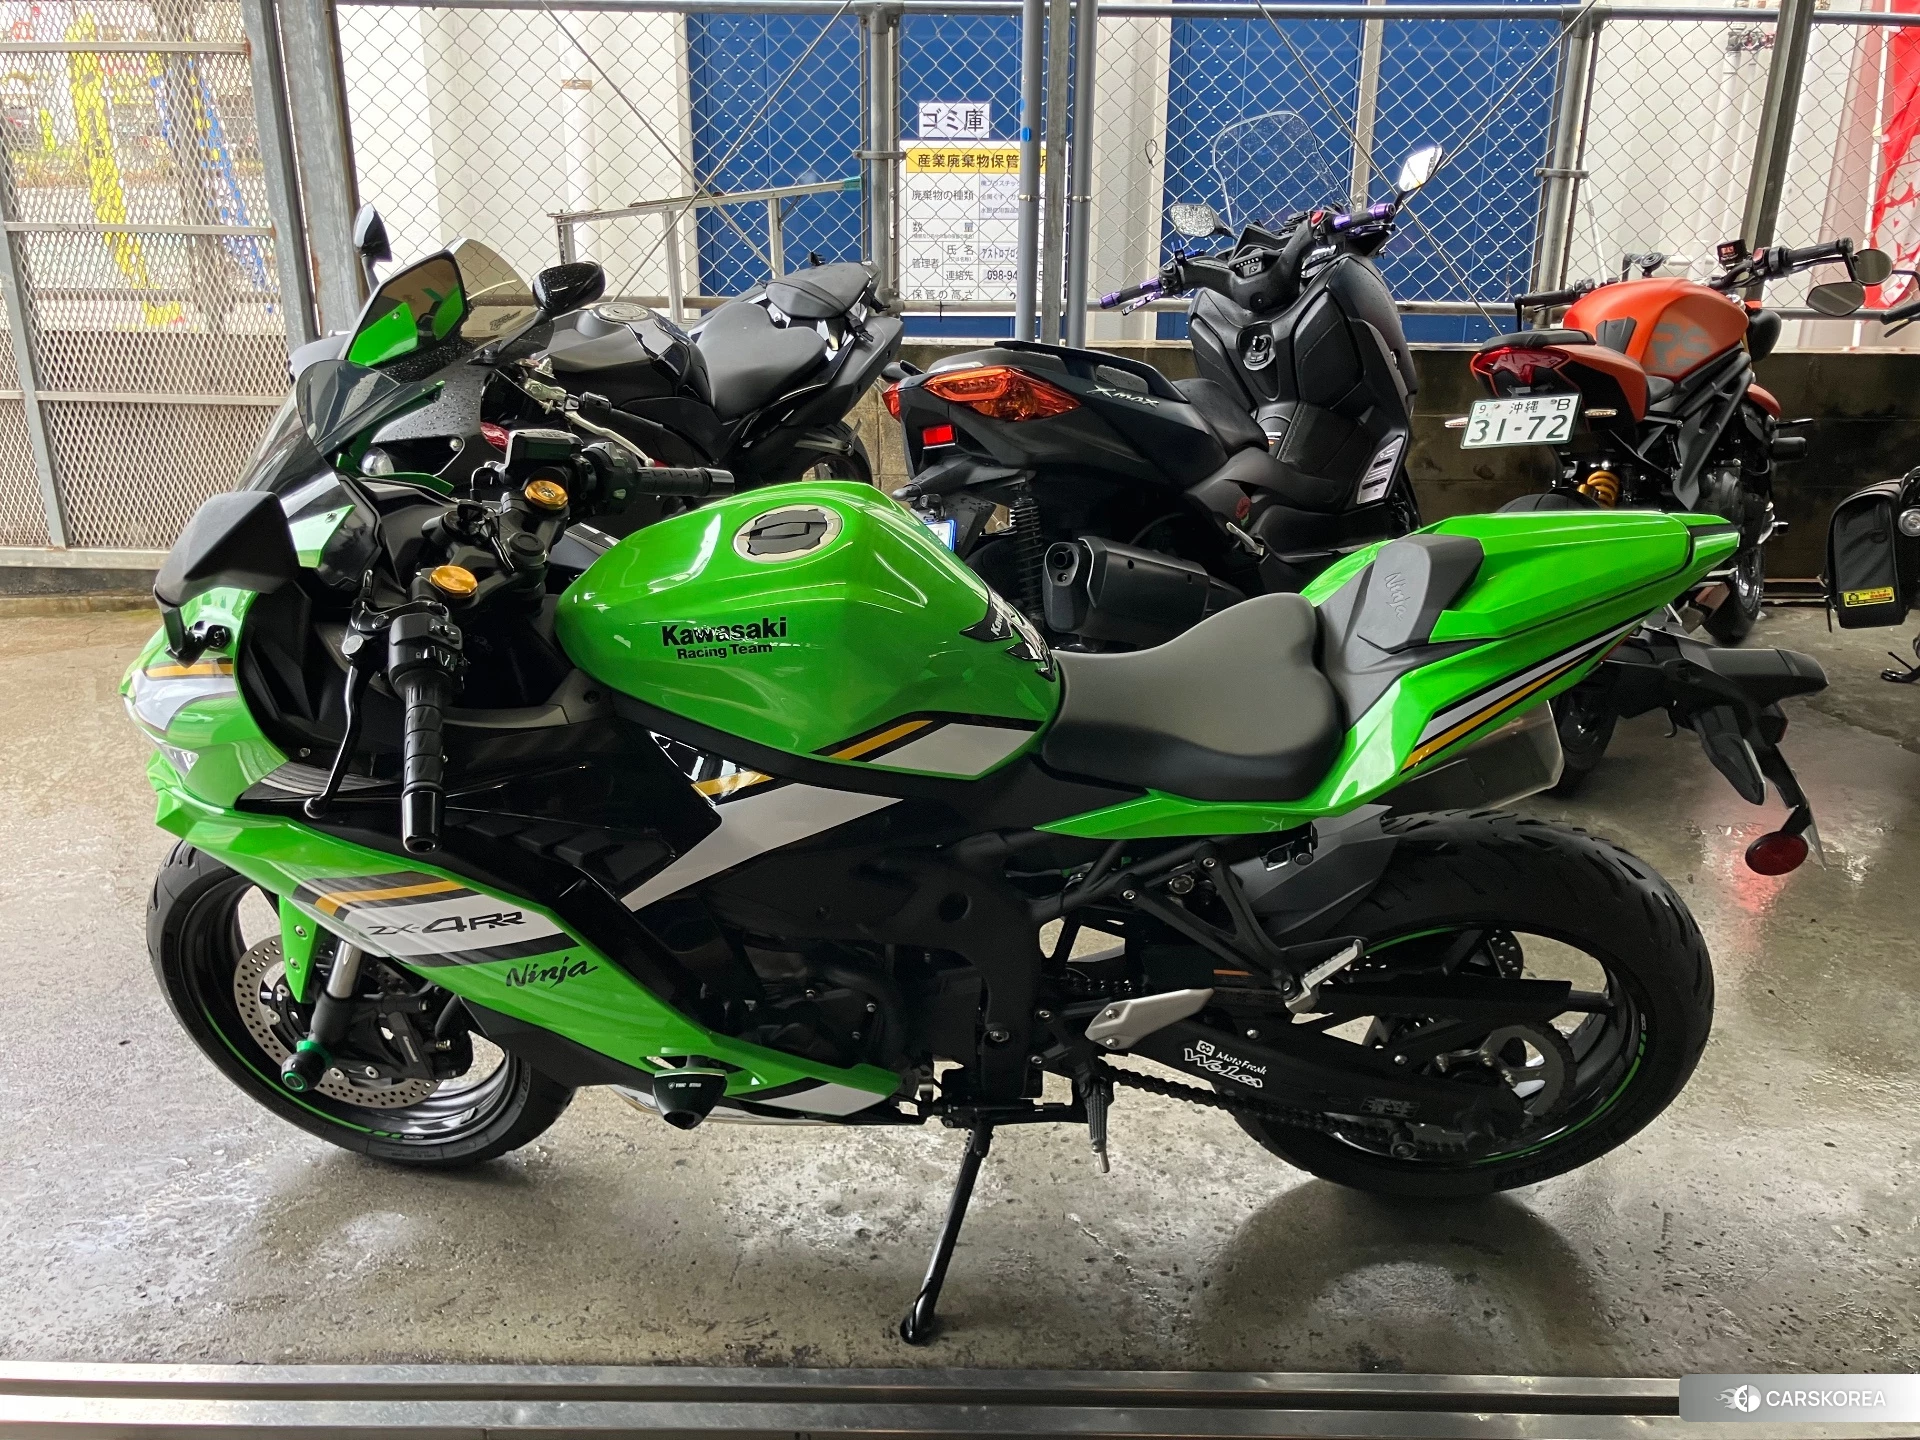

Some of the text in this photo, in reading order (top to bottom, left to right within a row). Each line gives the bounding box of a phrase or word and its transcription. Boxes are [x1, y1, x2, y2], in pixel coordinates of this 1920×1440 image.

[922, 108, 984, 132] ゴミ庫
[917, 153, 1046, 168] 産業廃棄物保管
[1509, 400, 1540, 414] 沖縄
[1469, 414, 1568, 444] 31-72
[661, 616, 787, 646] Kawasaki
[677, 643, 773, 660] Racing Team
[505, 956, 599, 988] Ninja
